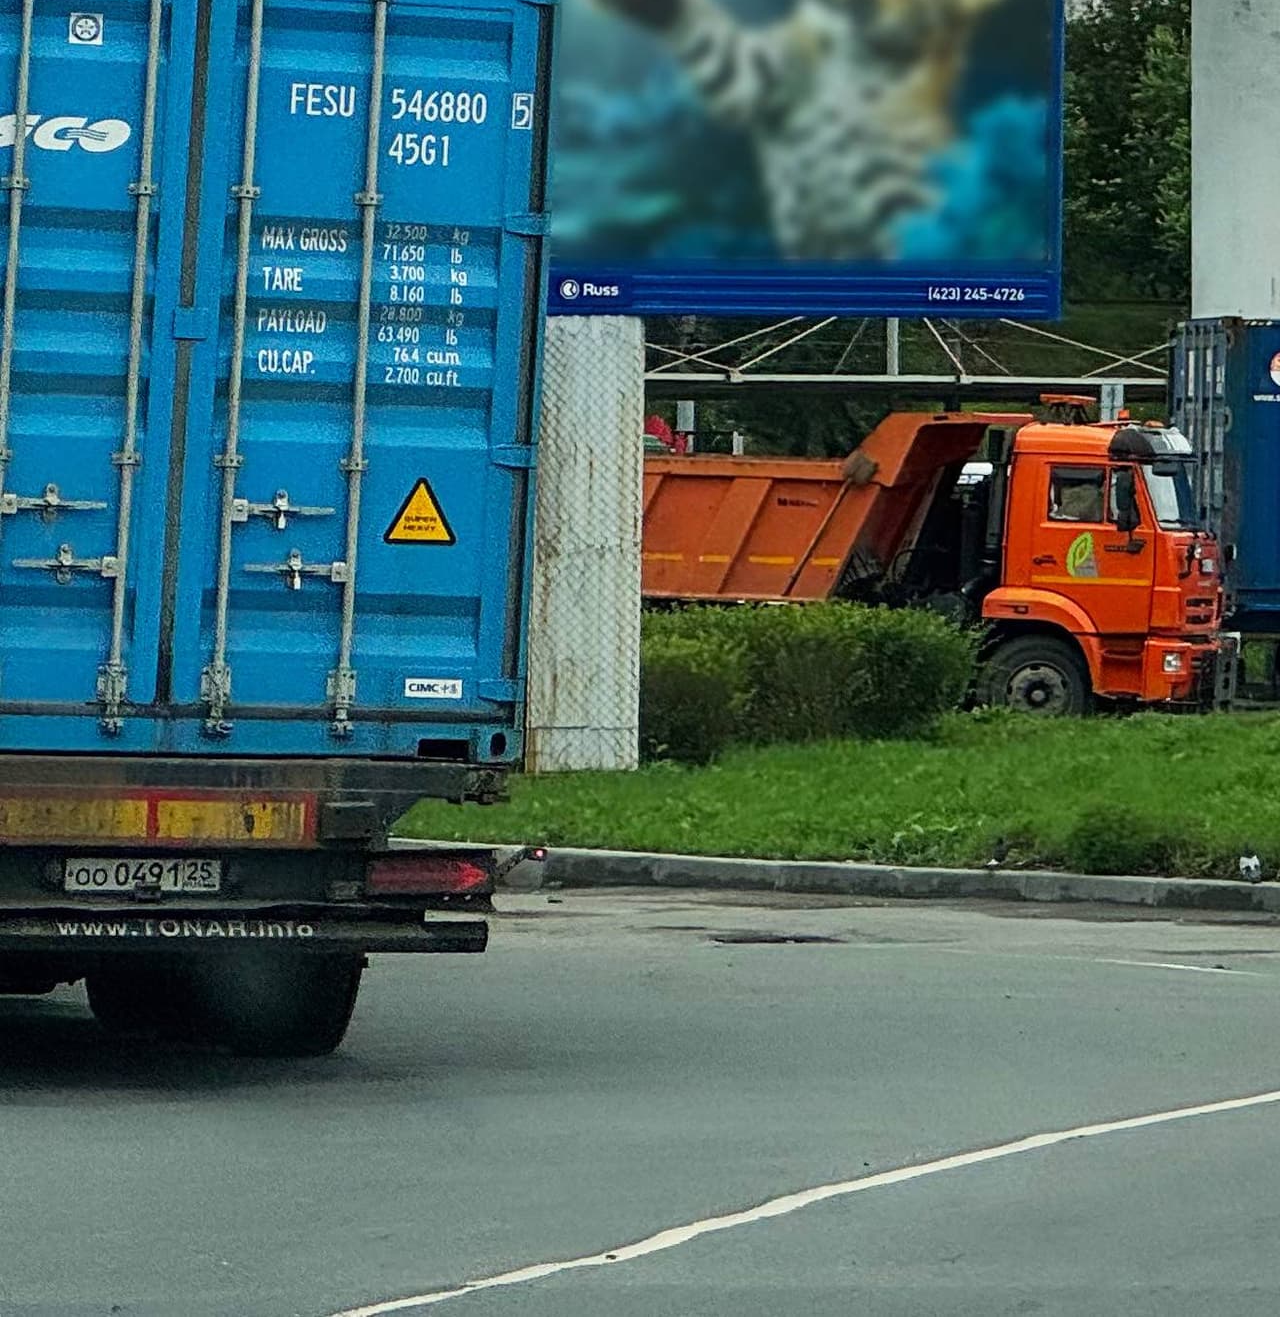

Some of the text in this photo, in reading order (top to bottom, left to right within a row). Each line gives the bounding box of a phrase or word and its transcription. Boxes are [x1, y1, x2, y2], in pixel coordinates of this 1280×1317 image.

[290, 83, 531, 128] FESU 546880 5
[388, 134, 449, 166] 45G1
[262, 225, 295, 250] MAX
[300, 229, 348, 252] GROSS
[383, 245, 463, 264] 71.650 lb
[262, 265, 468, 292] TARE 3.700 kg
[389, 285, 463, 304] 8.160 lb
[583, 282, 619, 296] Russ
[928, 287, 1025, 301] (423) 245-4726
[257, 309, 326, 333] PAYLOAD
[377, 327, 458, 345] 63.490 lb
[257, 349, 316, 375] CU.CAP.
[385, 368, 420, 384] 2.700
[408, 683, 440, 693] CIMC
[186, 862, 212, 882] 25
